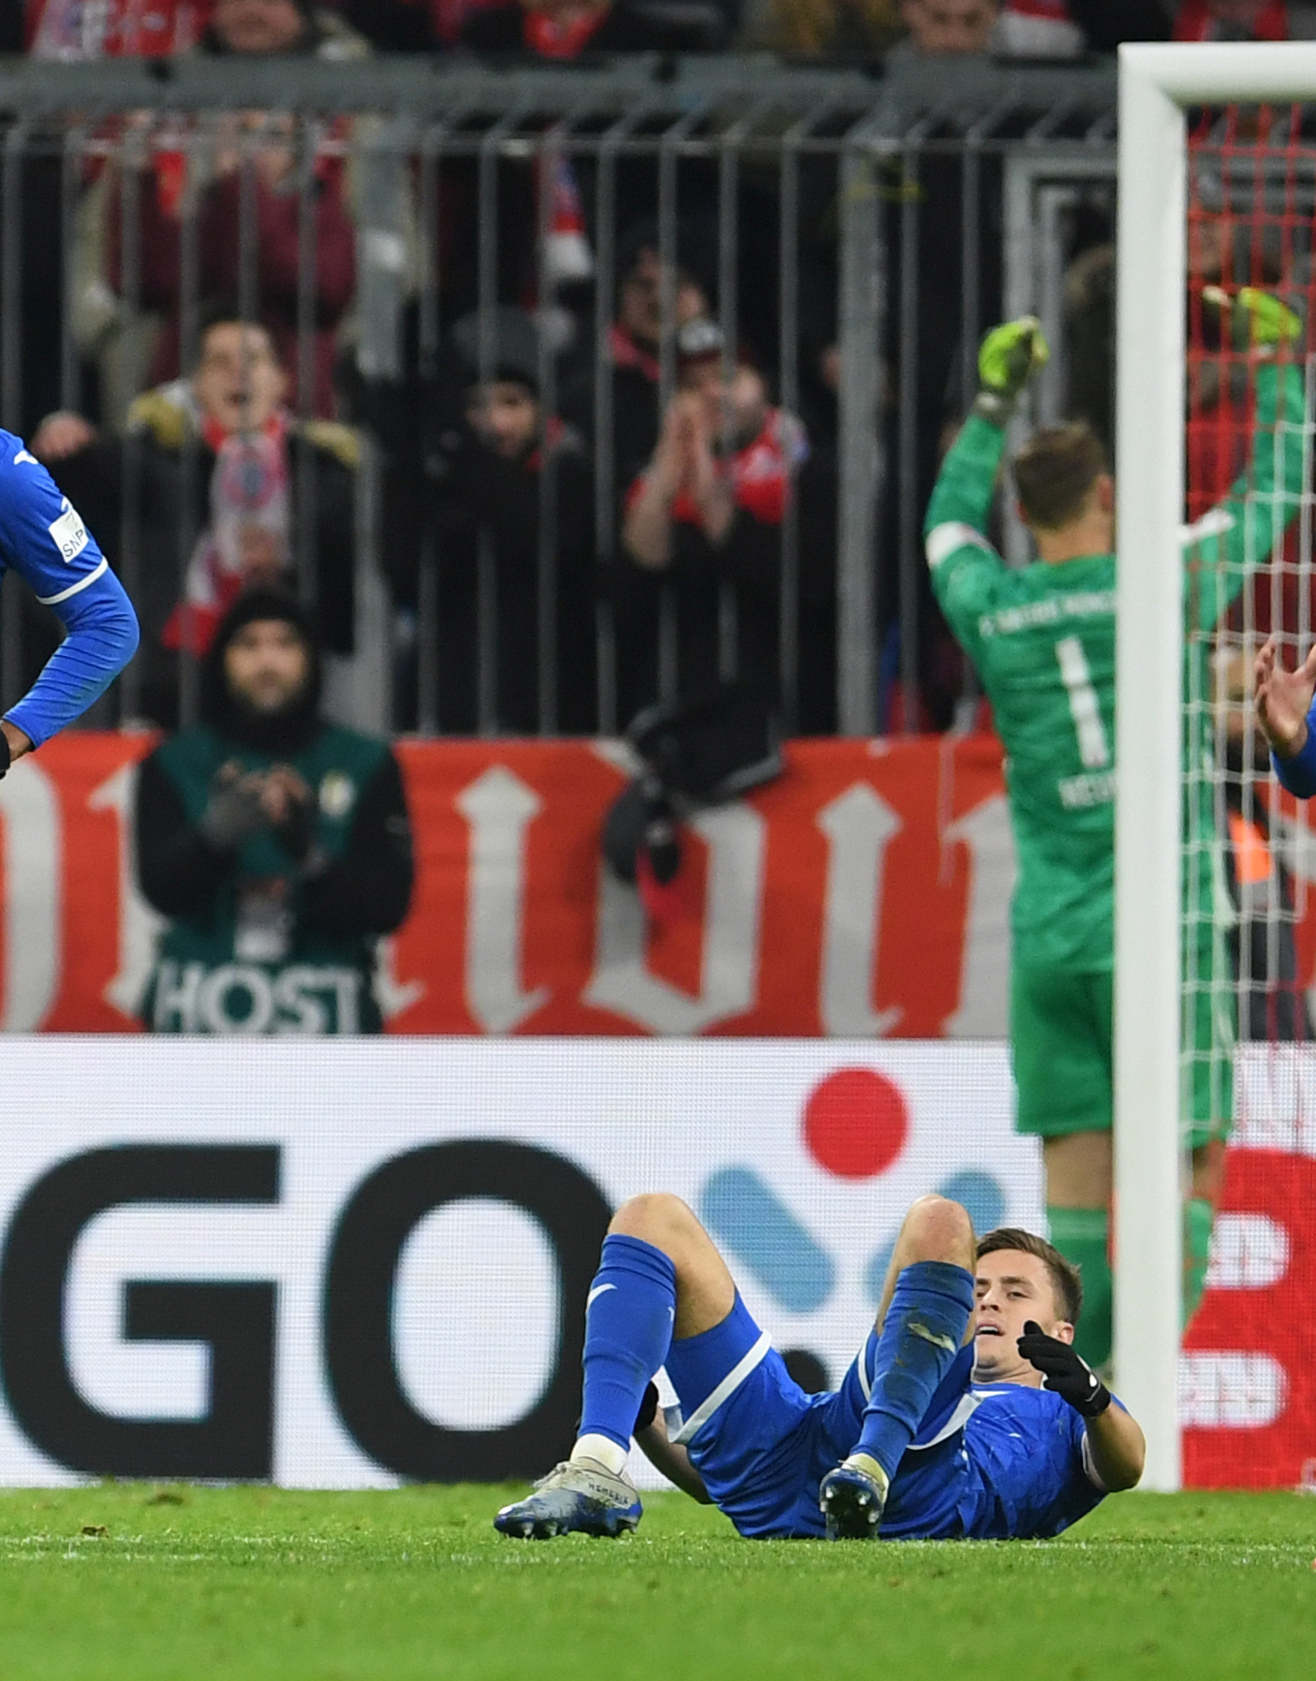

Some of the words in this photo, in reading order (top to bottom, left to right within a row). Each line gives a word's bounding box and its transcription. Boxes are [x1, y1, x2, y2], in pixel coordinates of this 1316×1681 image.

[62, 528, 84, 558] SNP
[1055, 634, 1109, 769] 1
[154, 961, 361, 1034] HOST
